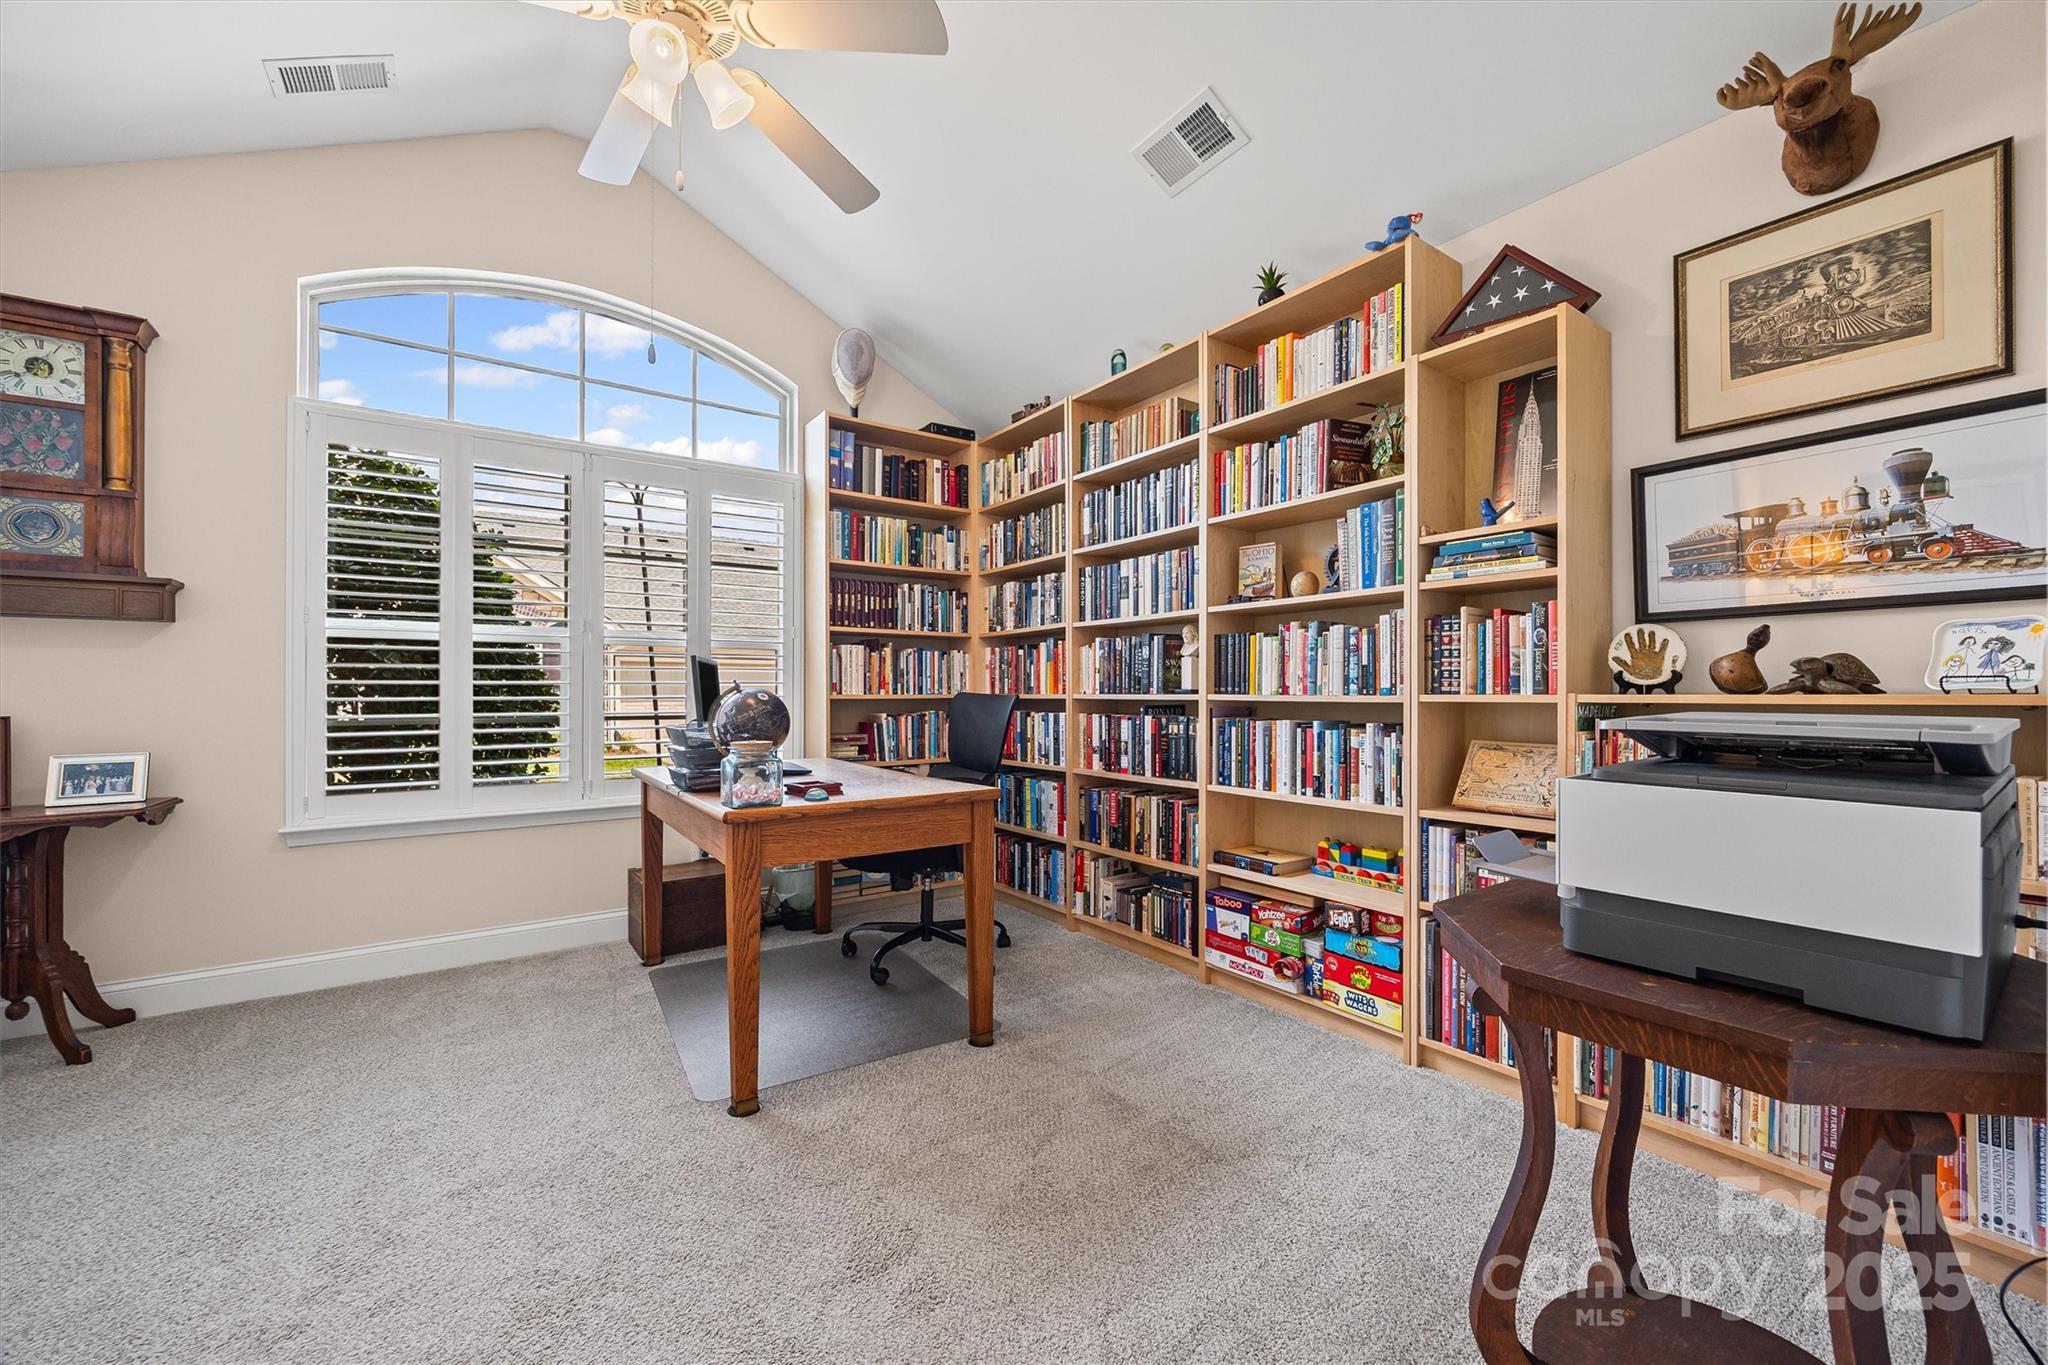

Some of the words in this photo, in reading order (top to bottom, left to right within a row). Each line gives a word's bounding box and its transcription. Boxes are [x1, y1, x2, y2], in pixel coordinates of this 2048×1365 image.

[1578, 704, 1616, 717] MADELINE
[1213, 895, 1242, 909] Taboo
[1258, 910, 1286, 920] Yahtzee
[1328, 910, 1354, 928] Jenga
[1229, 960, 1264, 980] MONOPOLY
[1347, 991, 1366, 1003] WITS
[1345, 999, 1378, 1015] WAGERS
[1992, 1148, 2001, 1177] ANCIENT
[2006, 1151, 2015, 1181] KNIGHTS
[1993, 1178, 2002, 1214] EGYPTIANS
[2007, 1187, 2016, 1216] CASTLES
